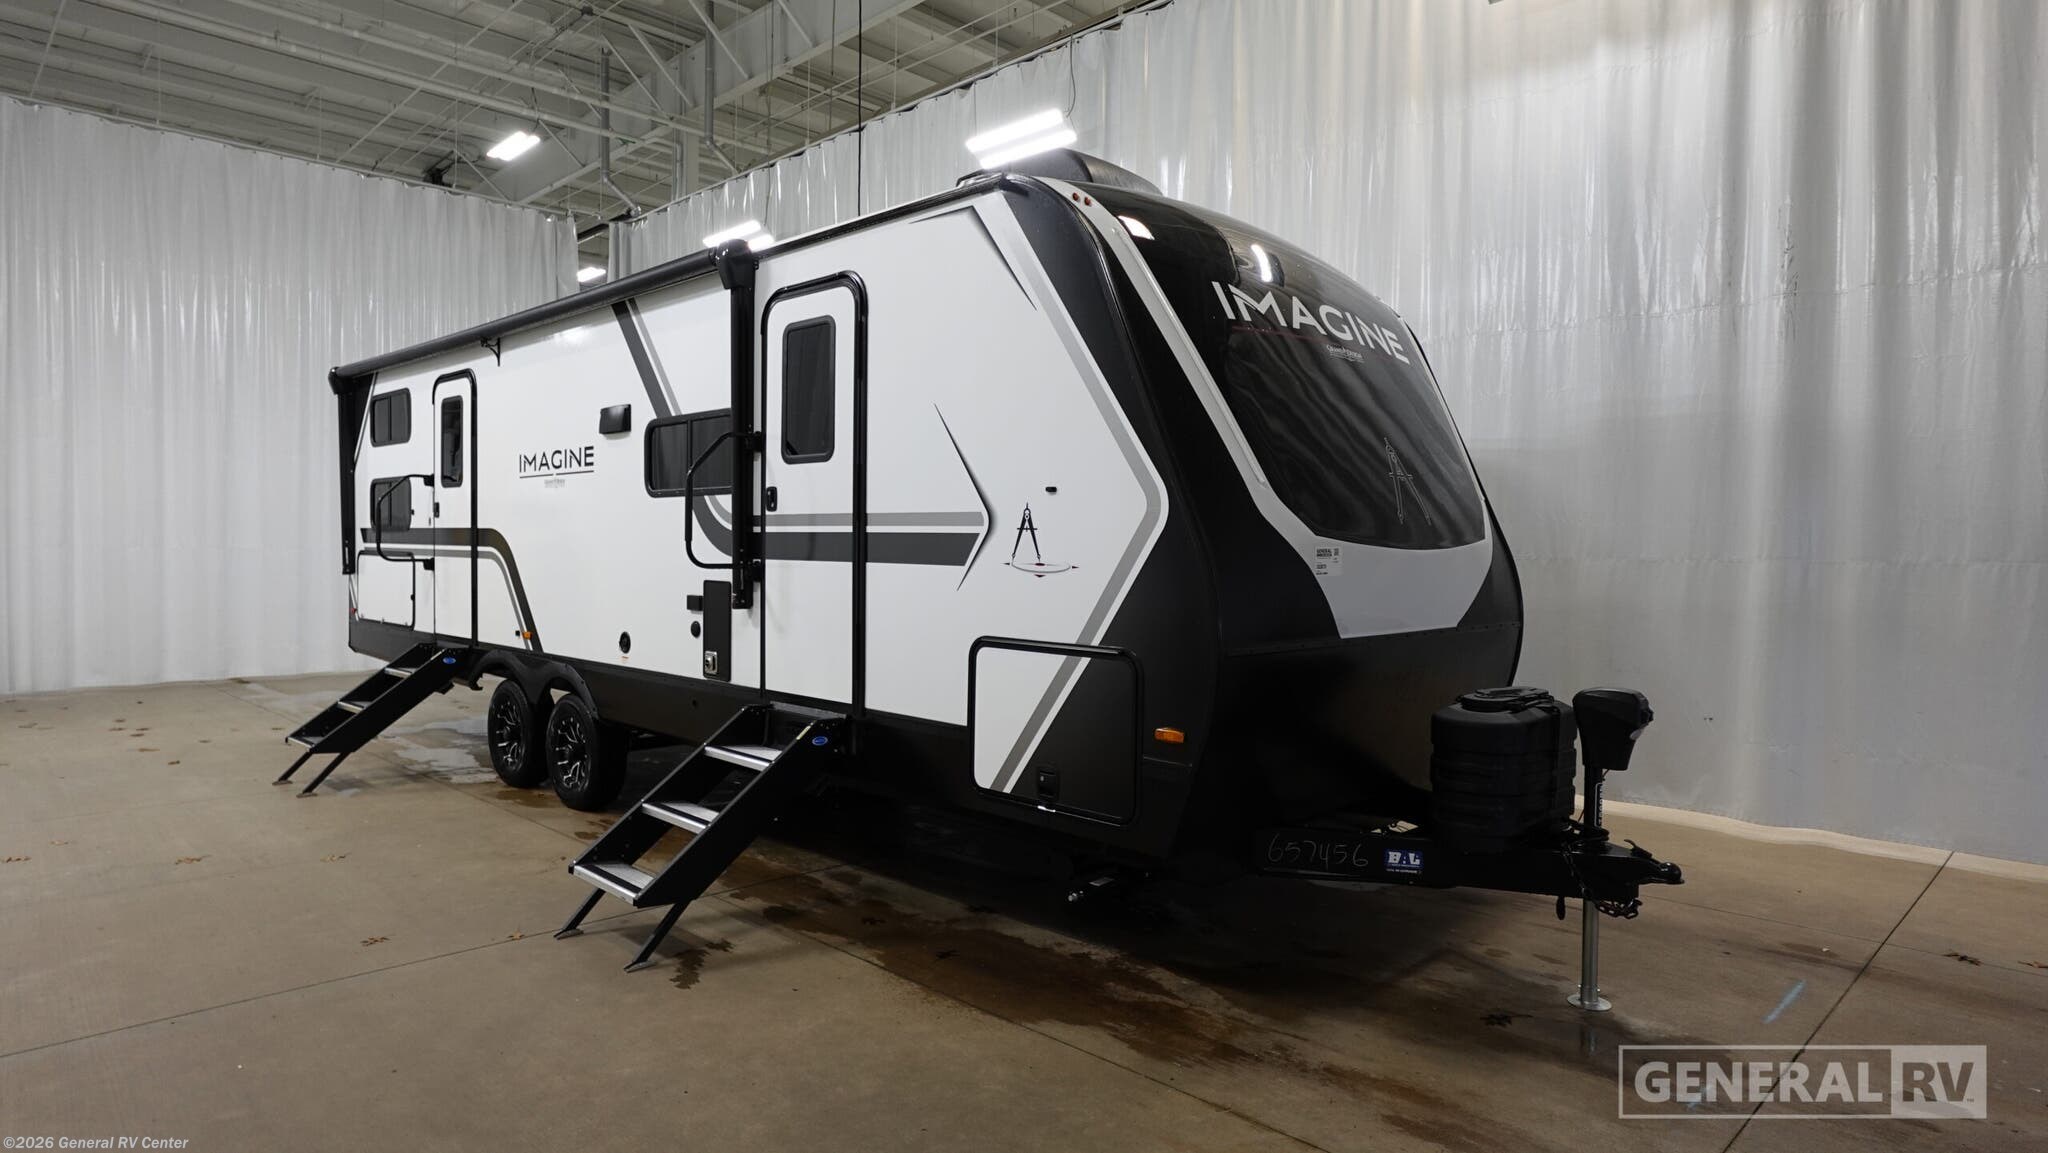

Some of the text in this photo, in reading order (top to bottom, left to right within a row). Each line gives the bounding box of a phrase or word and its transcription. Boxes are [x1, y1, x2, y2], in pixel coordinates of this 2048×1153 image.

[1211, 281, 1410, 365] IMAGINE
[519, 445, 594, 473] IMAGINE
[1268, 833, 1369, 870] 657456
